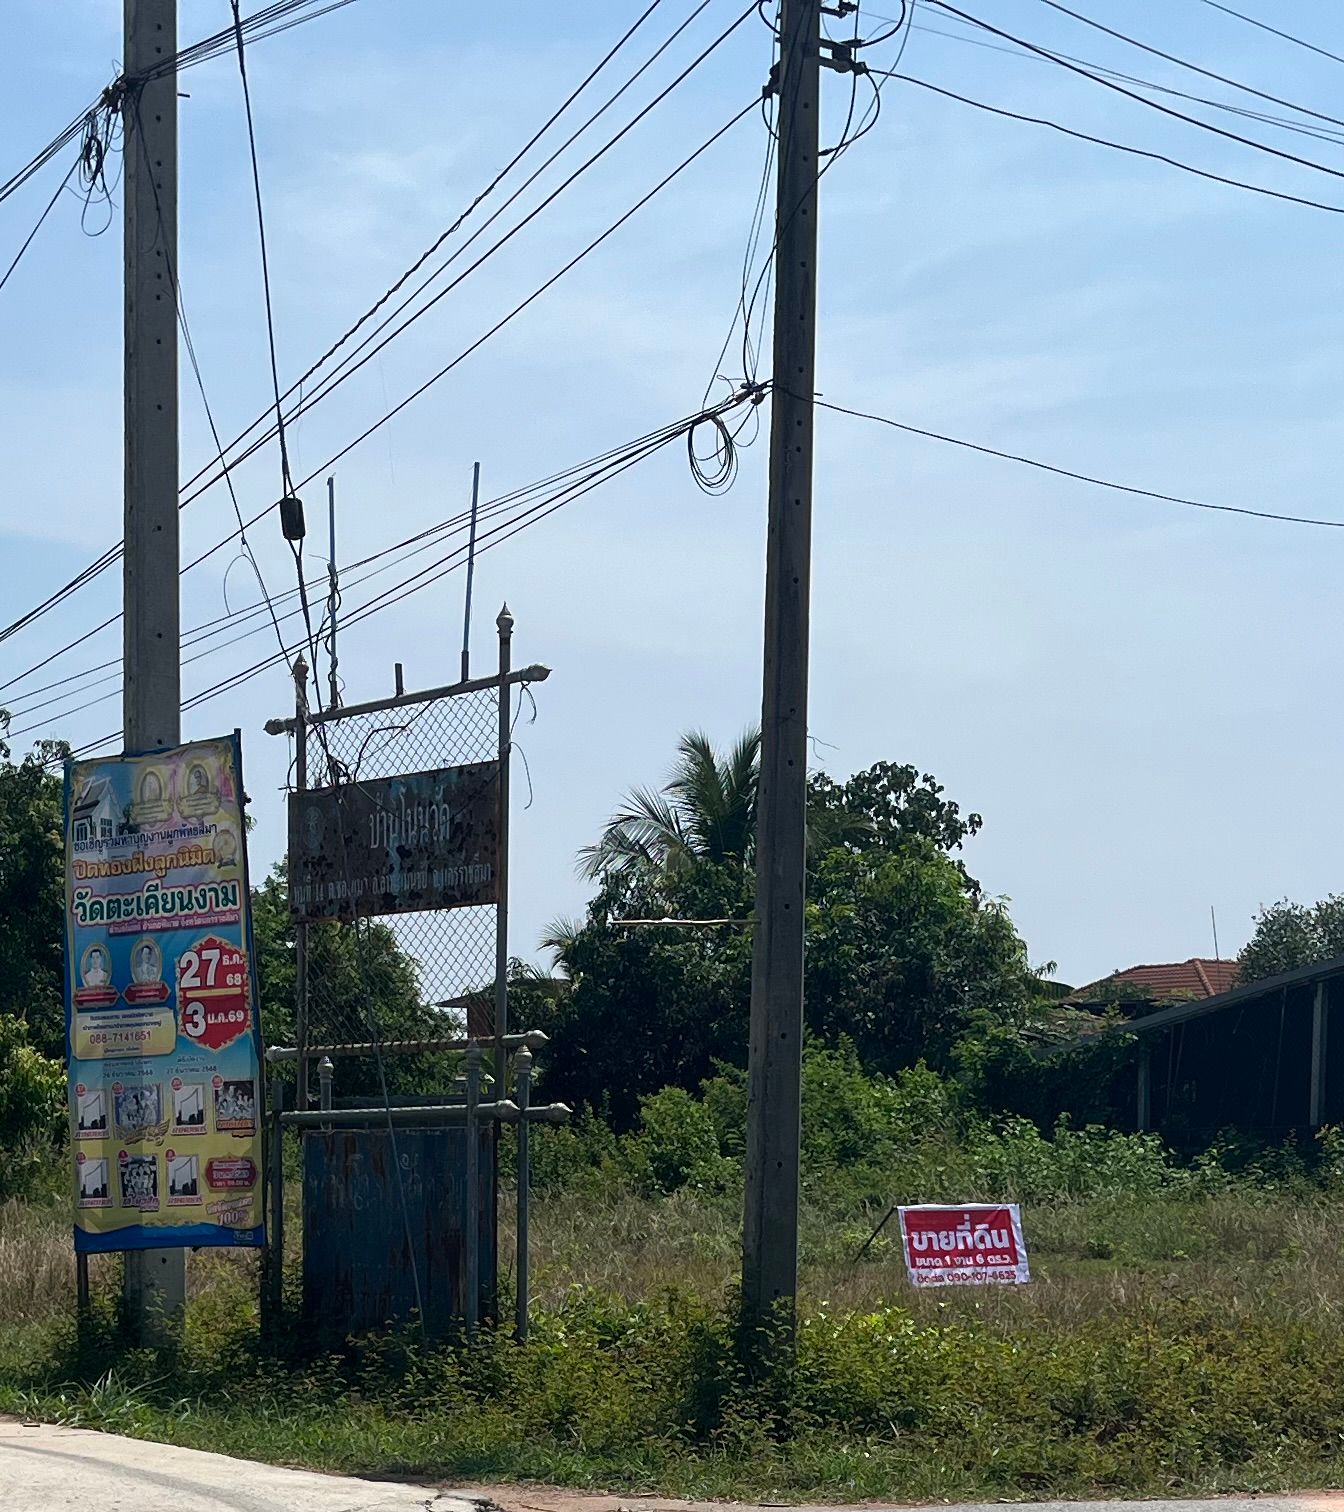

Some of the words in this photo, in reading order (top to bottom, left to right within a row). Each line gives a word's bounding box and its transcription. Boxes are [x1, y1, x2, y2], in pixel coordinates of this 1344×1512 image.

[73, 844, 216, 880] ปิดทองฝังลูกนิมิต
[74, 882, 239, 922] วัดตะเคียนงาม
[180, 949, 220, 988] 27
[222, 954, 244, 965] ธ.ค.
[226, 973, 242, 985] 68
[185, 1001, 206, 1037] 3
[911, 1214, 1010, 1251] ขายที่ดิน
[945, 1256, 951, 1265] 1
[954, 1256, 973, 1265] งาน
[976, 1254, 984, 1264] 6
